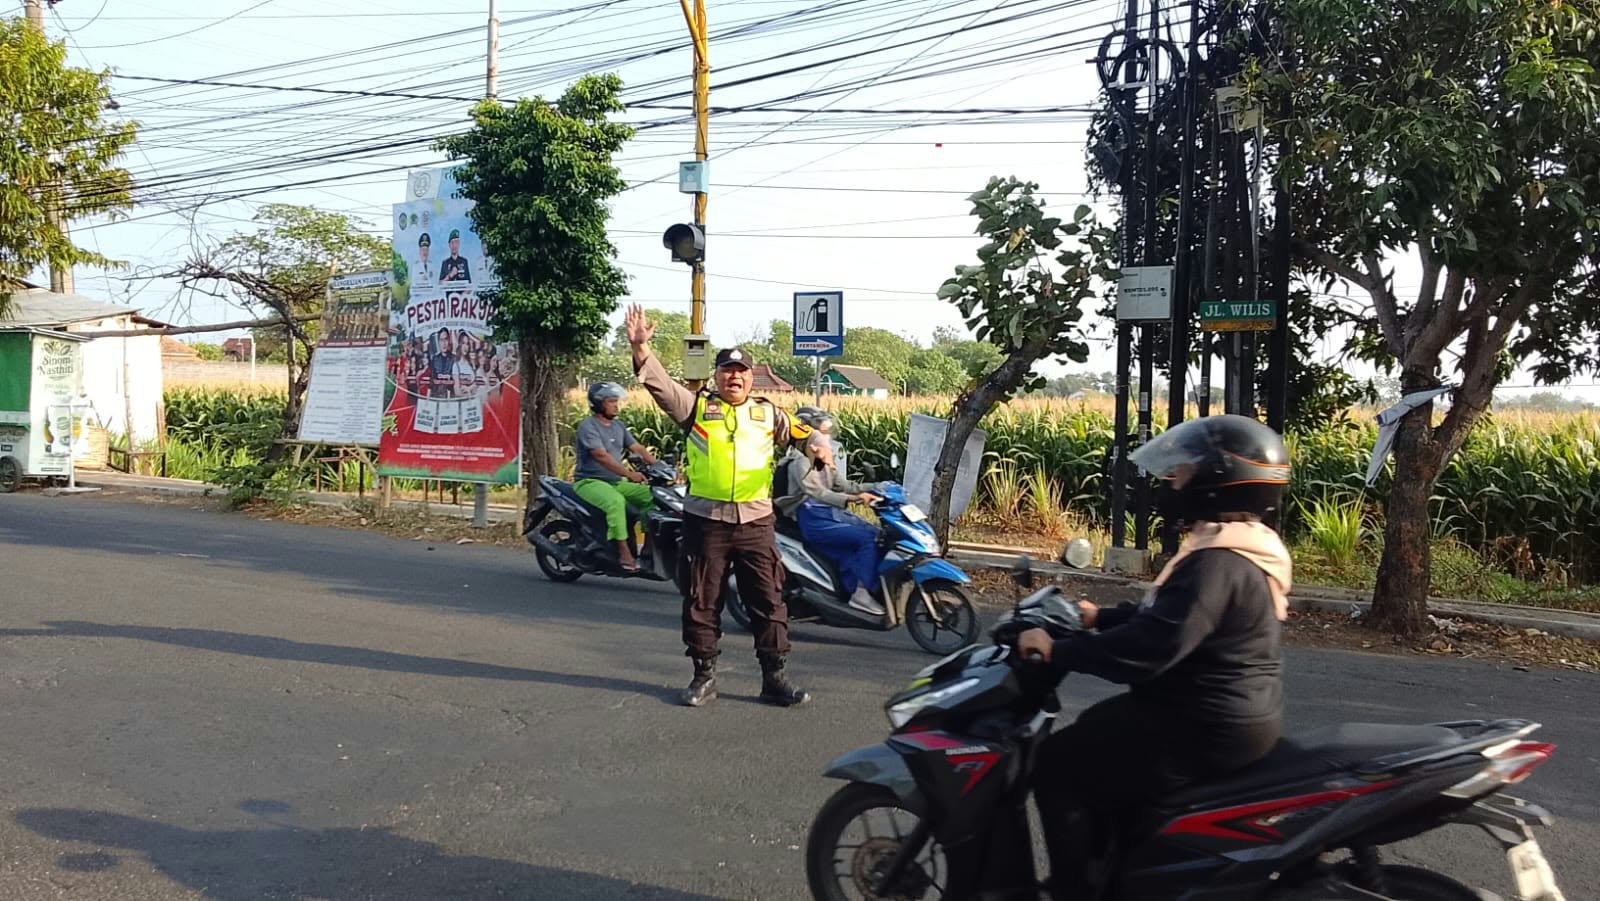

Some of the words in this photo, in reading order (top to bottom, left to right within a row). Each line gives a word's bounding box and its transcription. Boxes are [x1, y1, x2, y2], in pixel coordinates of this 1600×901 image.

[407, 299, 446, 328] PESTA
[450, 296, 497, 321] RAKYA
[1205, 304, 1225, 317] JL.
[1230, 303, 1271, 316] WILIS
[42, 355, 72, 366] Sinom
